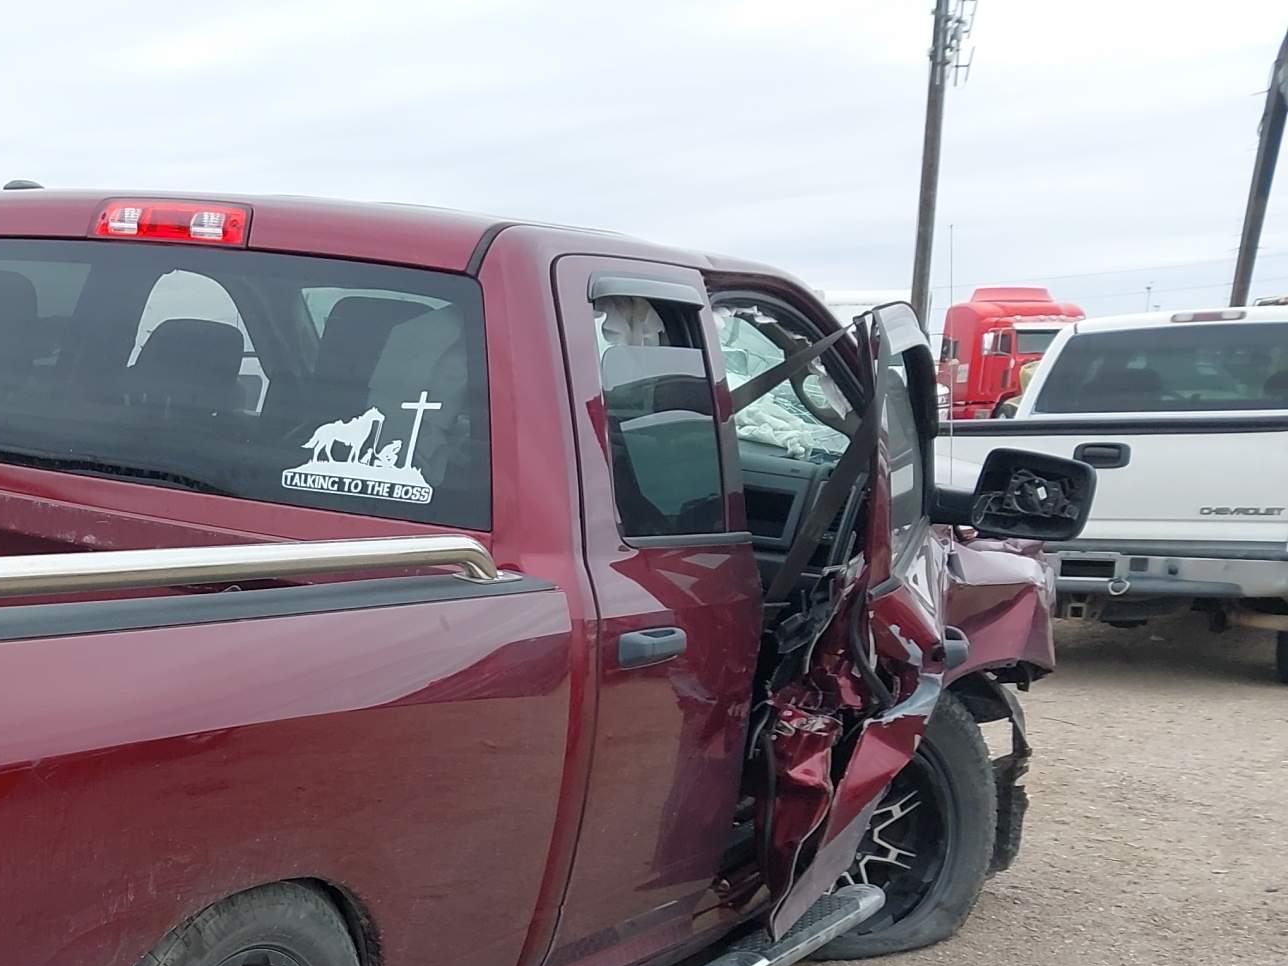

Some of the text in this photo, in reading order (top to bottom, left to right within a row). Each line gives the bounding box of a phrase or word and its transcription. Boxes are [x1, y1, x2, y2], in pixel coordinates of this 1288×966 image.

[284, 472, 430, 501] TALKING TO THE BOSS
[1199, 507, 1287, 516] CHEVROLET
